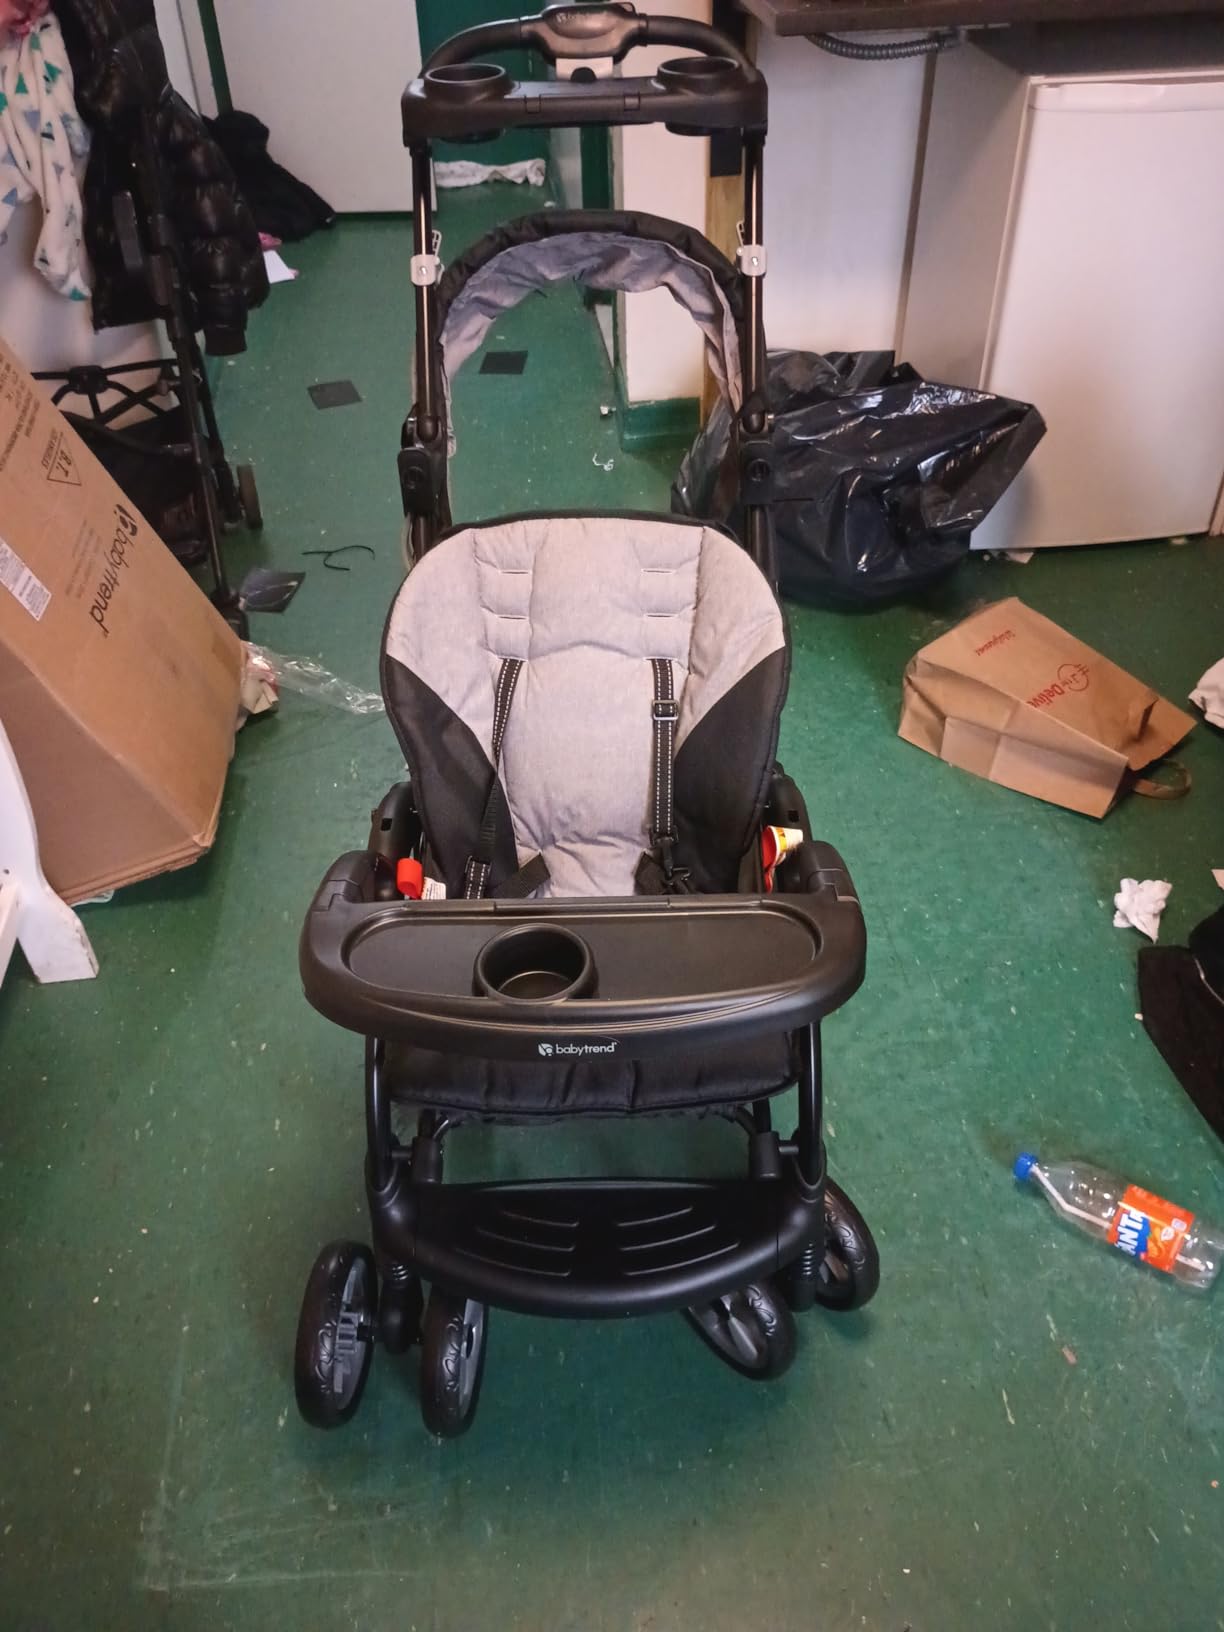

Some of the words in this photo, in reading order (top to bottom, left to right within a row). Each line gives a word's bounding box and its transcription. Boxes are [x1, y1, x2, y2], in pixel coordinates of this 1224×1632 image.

[89, 527, 135, 634] babytrend
[555, 1042, 616, 1056] babytrend
[1113, 1209, 1146, 1256] ANTA
